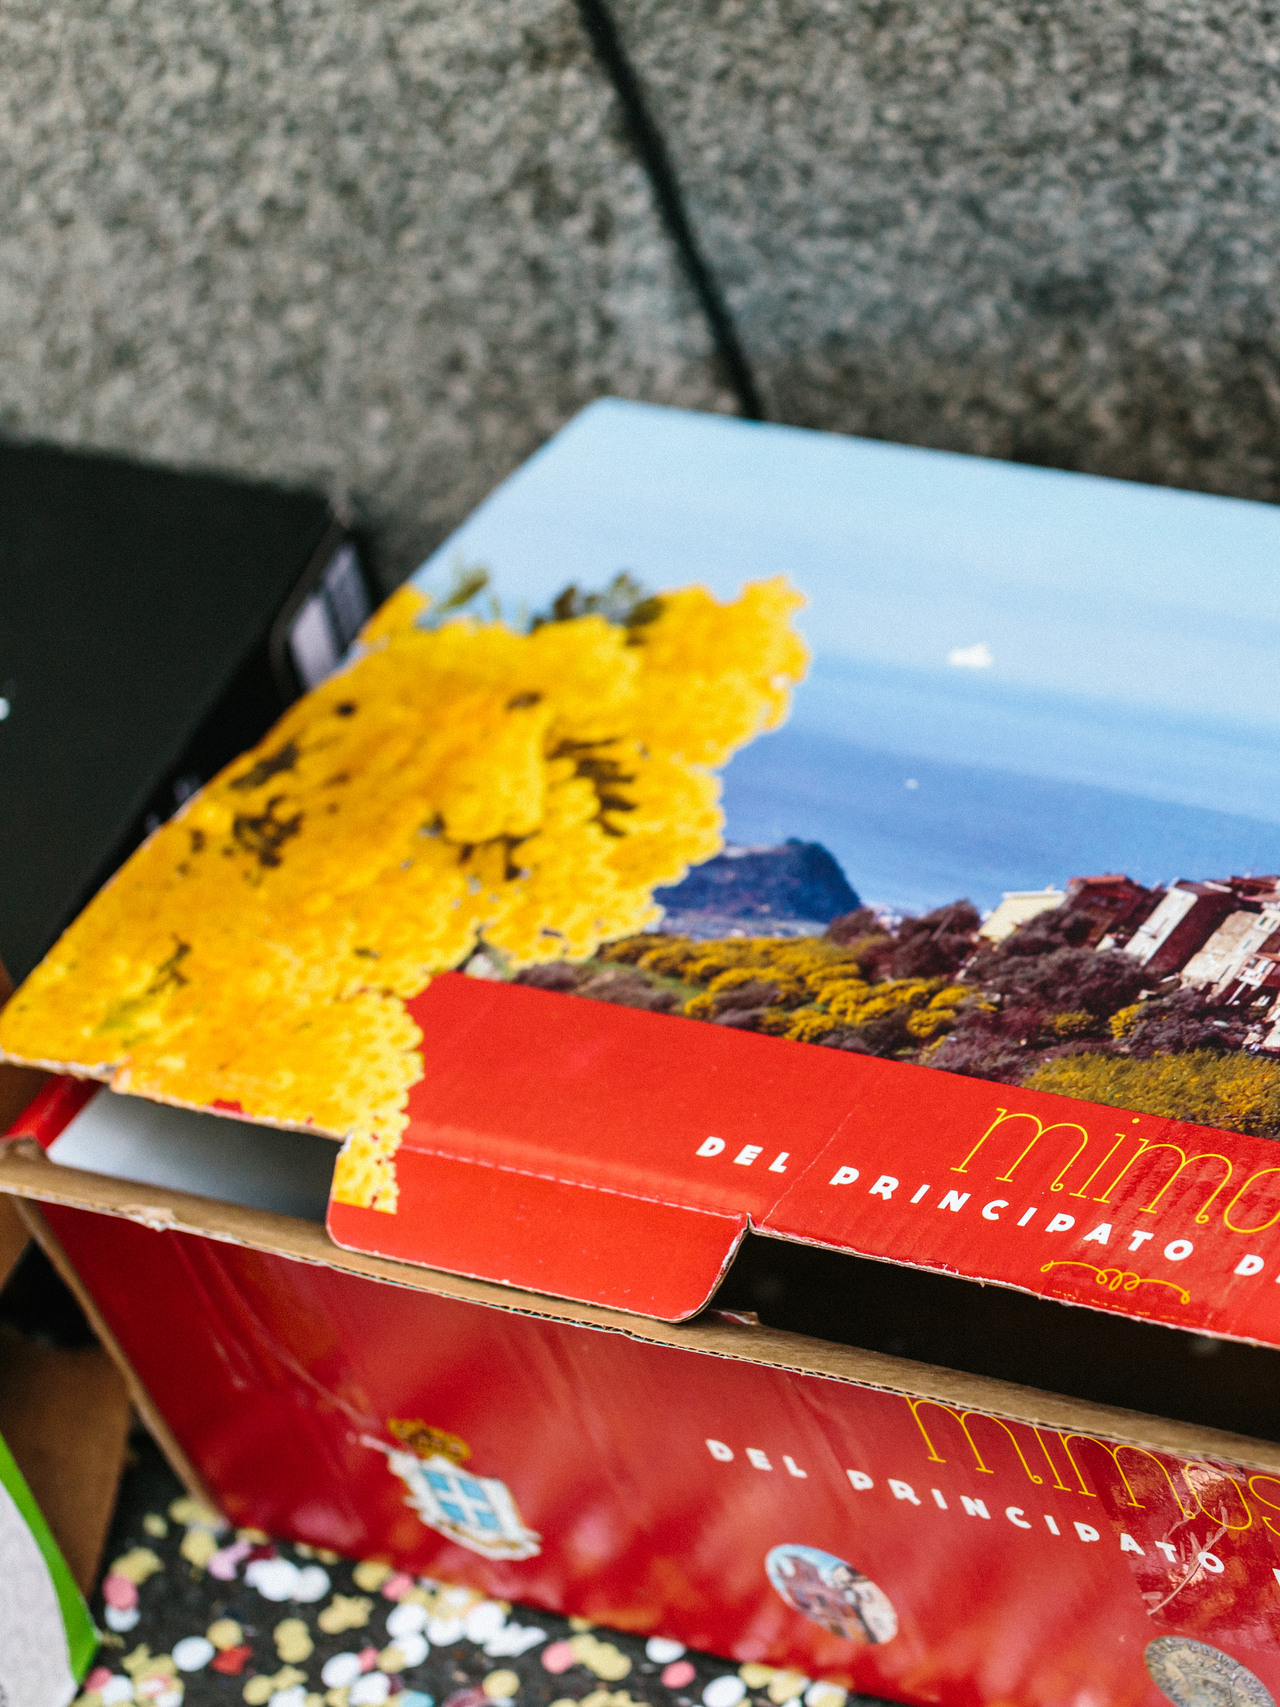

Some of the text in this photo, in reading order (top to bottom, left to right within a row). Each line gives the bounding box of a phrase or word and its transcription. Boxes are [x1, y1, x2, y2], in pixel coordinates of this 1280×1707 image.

[696, 1136, 788, 1173] DEL
[830, 1166, 1194, 1261] PRINCIPATO
[705, 1439, 808, 1478] DEL
[847, 1470, 1225, 1573] PRINCIPATO
